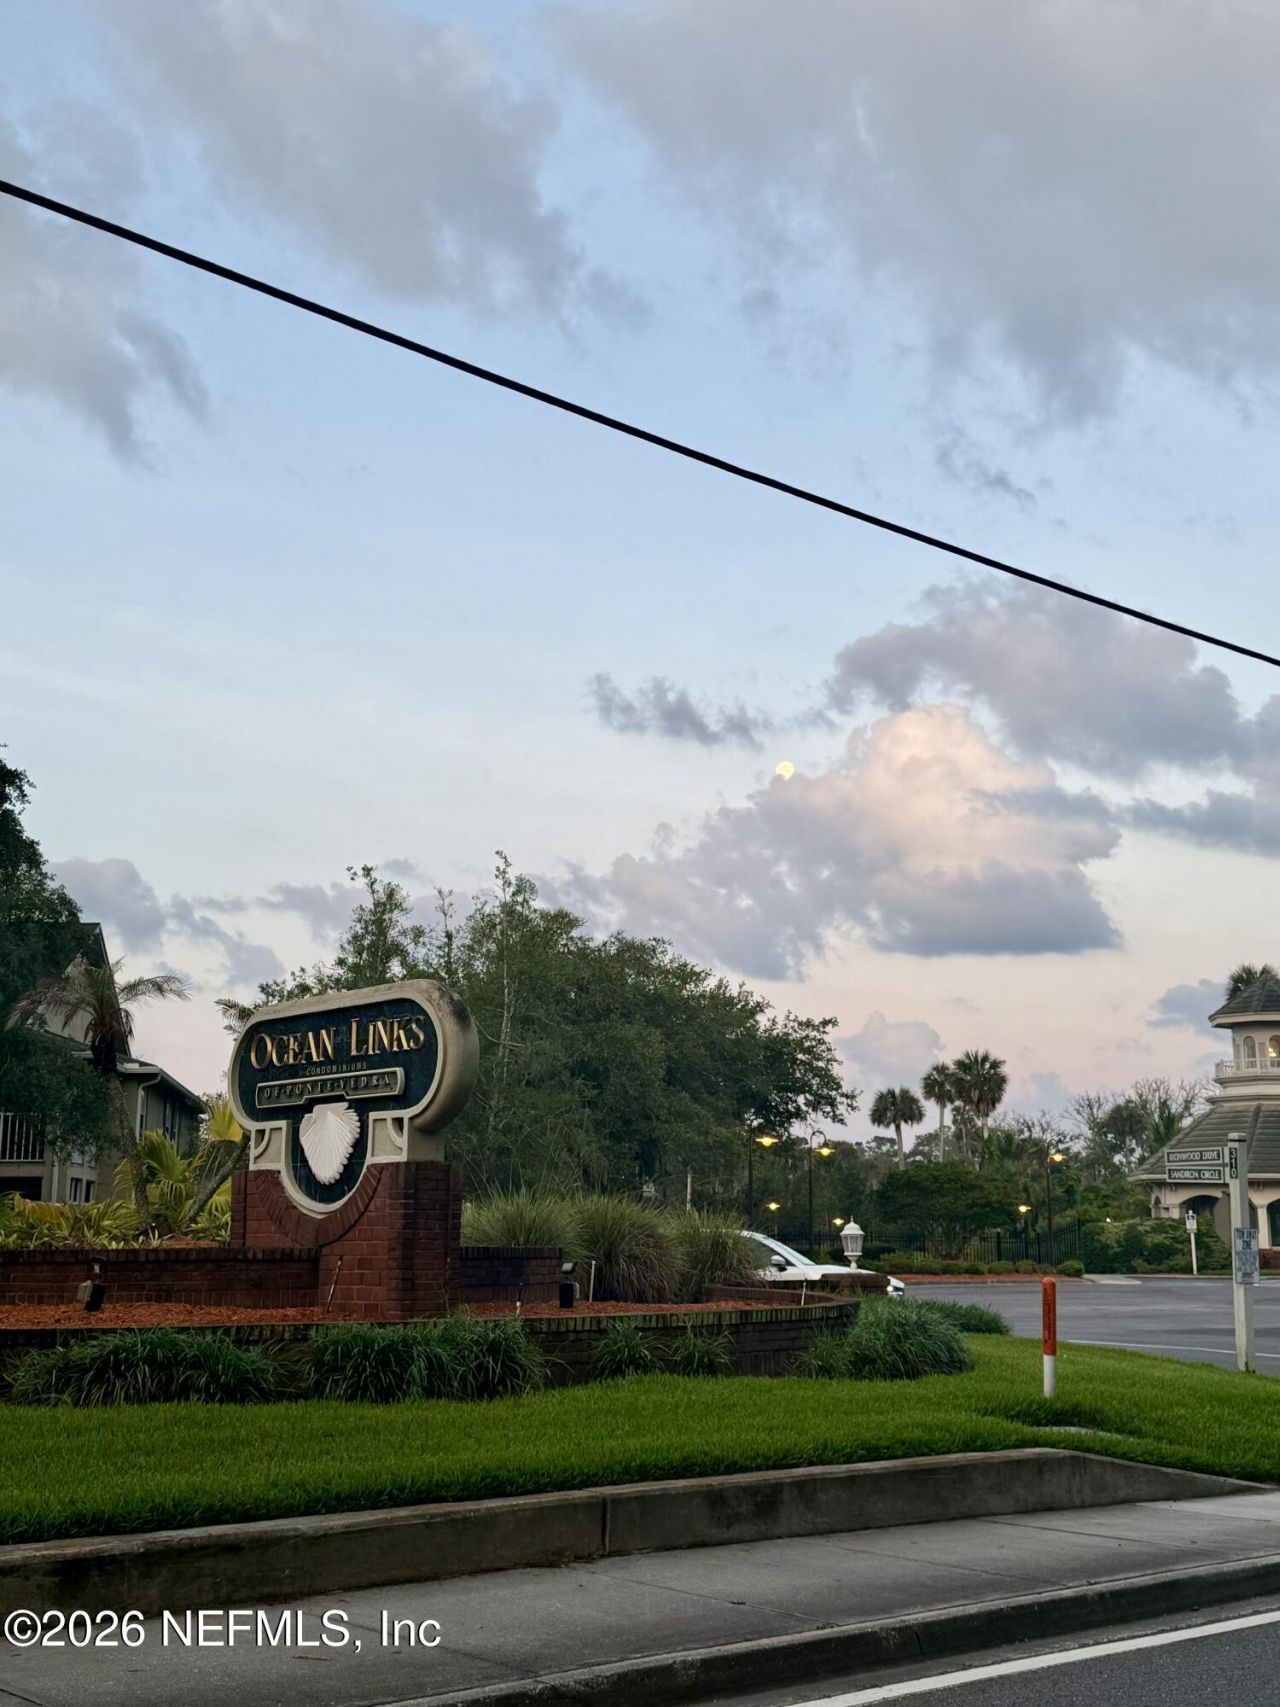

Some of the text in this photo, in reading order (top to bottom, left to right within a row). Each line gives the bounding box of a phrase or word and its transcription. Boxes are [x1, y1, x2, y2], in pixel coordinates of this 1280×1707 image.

[250, 1015, 425, 1069] OCEAN LINKS
[306, 1061, 367, 1075] CONDOMINIUMS
[1202, 1151, 1219, 1160] DRIVE
[1200, 1170, 1219, 1179] CIRCLE
